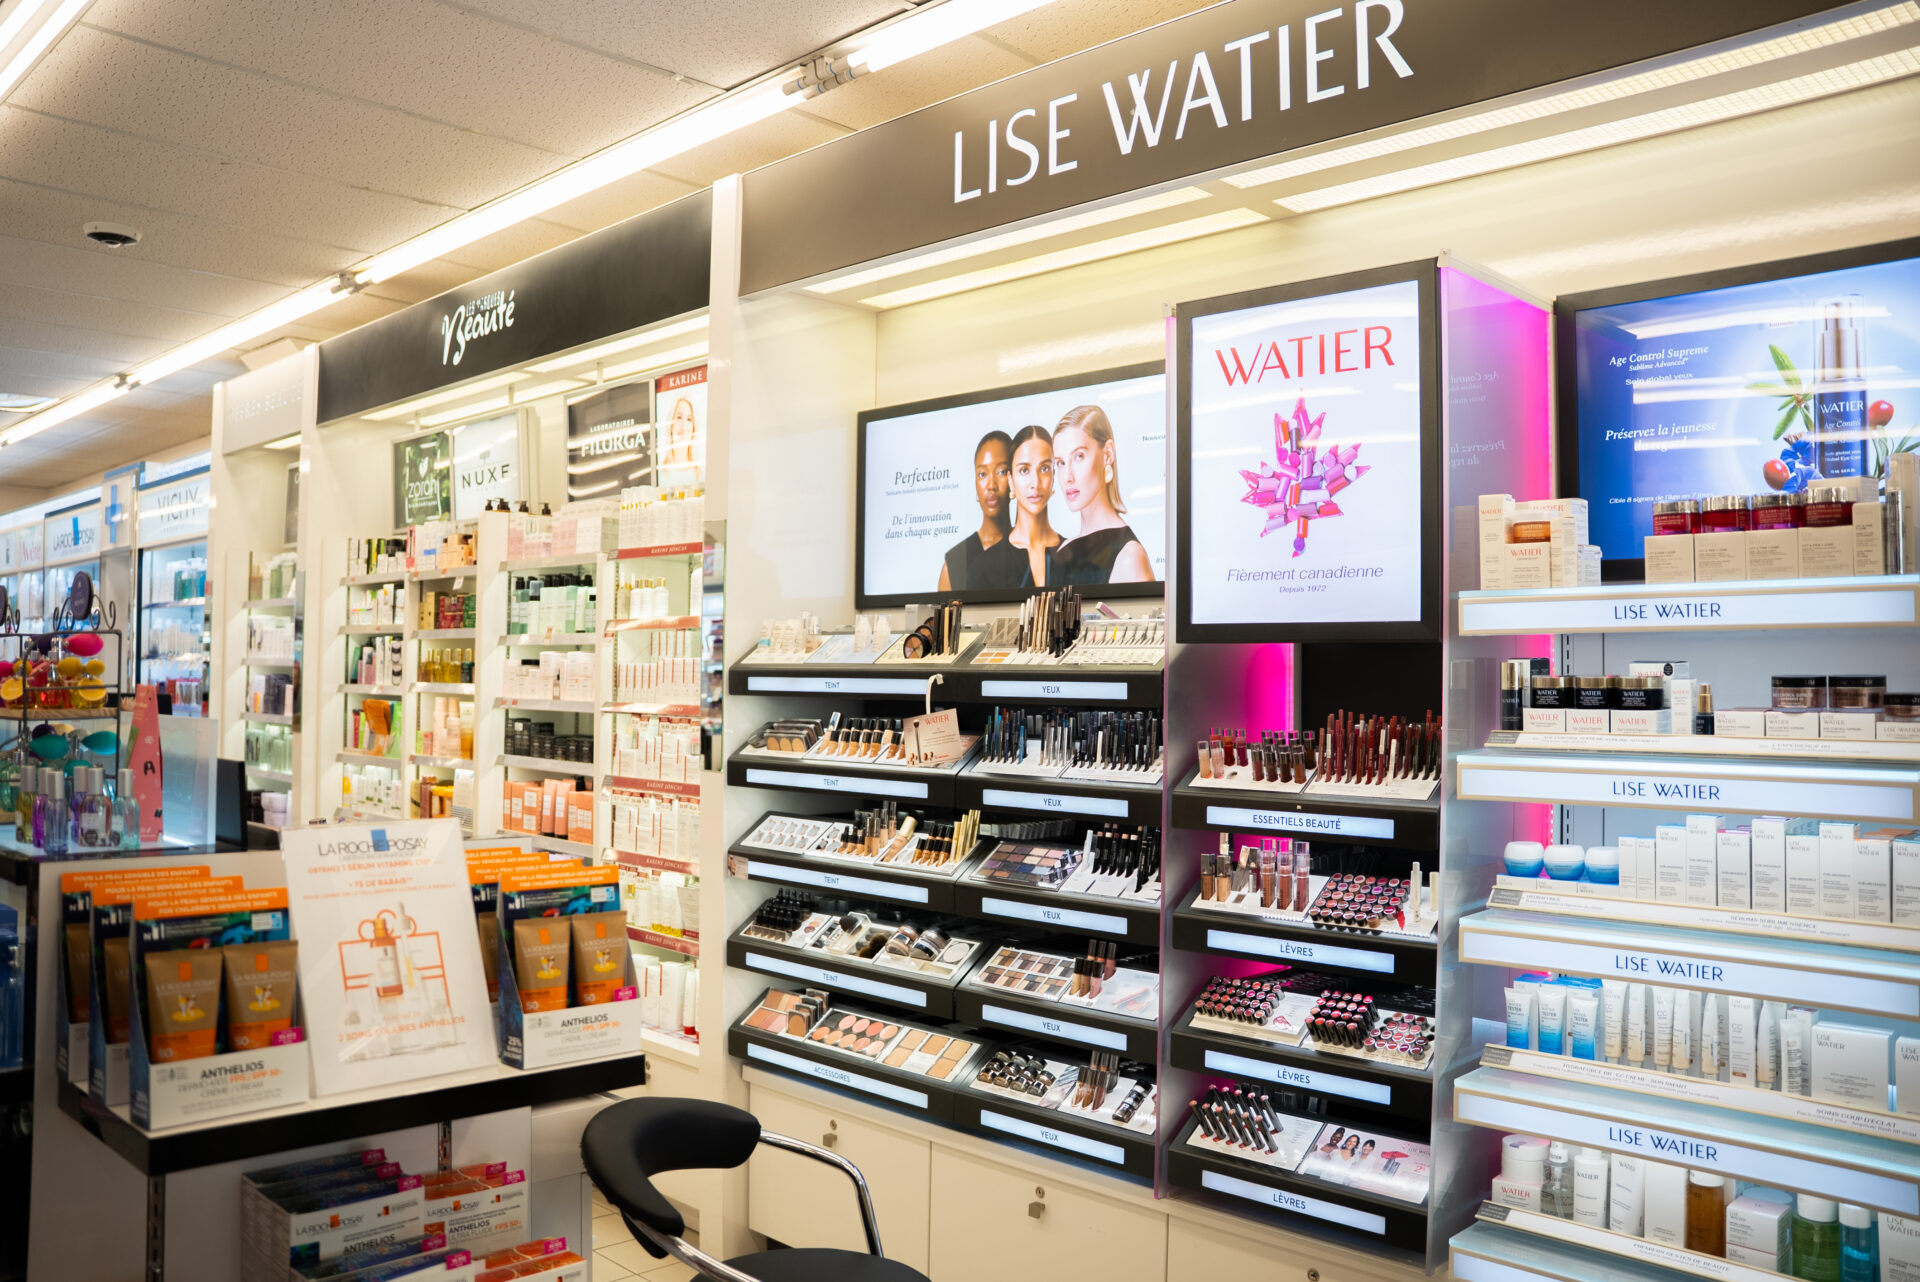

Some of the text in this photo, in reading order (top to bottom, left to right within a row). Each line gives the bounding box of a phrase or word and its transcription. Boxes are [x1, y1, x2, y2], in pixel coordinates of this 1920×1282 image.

[954, 0, 1414, 204] LISE WATIER
[441, 289, 515, 366] Beauté
[1214, 325, 1395, 387] WATIER
[1609, 345, 1710, 367] Age Control Supreme
[1628, 362, 1654, 372] Sublime
[668, 370, 703, 388] KARINE
[1820, 400, 1864, 414] WATIER
[1605, 419, 1718, 441] Préservez la jeunesse
[580, 431, 646, 457] FILORGA
[894, 466, 950, 487] Perfection
[157, 487, 199, 522] VICHY
[892, 510, 952, 526] De l'innovation
[885, 525, 960, 540] dans chaque goutte
[1510, 548, 1543, 557] WATIER
[1226, 564, 1385, 583] Fièrement canadienne
[1279, 584, 1327, 594] Depuis 1972
[1614, 602, 1722, 620] LISE WATIER
[824, 681, 840, 689] TEINT
[1041, 685, 1061, 694] YEUX
[924, 714, 949, 725] WATIER
[1529, 713, 1559, 721] WATIER
[1571, 716, 1603, 725] WATIER
[1618, 717, 1647, 725] WATIER
[823, 778, 839, 787] TEINT
[1613, 780, 1721, 801] LISE WATIER
[1043, 797, 1062, 807] YEUX
[1252, 814, 1341, 830] ESSENTIELS BEAUTÉ
[318, 843, 337, 857] LA
[388, 837, 428, 851] POSAY
[824, 875, 840, 885] TEINT
[1042, 909, 1061, 920] YEUX
[1279, 942, 1314, 957] LÈVRES
[1615, 954, 1724, 982] LISE WATIER
[823, 973, 838, 983] TEINT
[560, 1013, 609, 1028] ANTHELIOS
[1042, 1021, 1061, 1032] YEUX
[1816, 1033, 1831, 1041] LISE
[1816, 1040, 1845, 1050] WATIER
[1901, 1046, 1917, 1054] LISE
[200, 1060, 265, 1080] ANTHELIOS
[814, 1065, 851, 1083] ACCESSOIRES
[1276, 1067, 1311, 1085] LÈVRES
[1039, 1129, 1059, 1142] YEUX
[1608, 1126, 1718, 1162] LISE WATIER
[1576, 1170, 1599, 1181] WATIER
[1501, 1185, 1531, 1198] WATIER
[1272, 1192, 1307, 1210] LÈVRES
[449, 1220, 490, 1234] ANTHELIOS
[1886, 1216, 1905, 1226] LISE
[343, 1234, 396, 1255] ANTHELIOS
